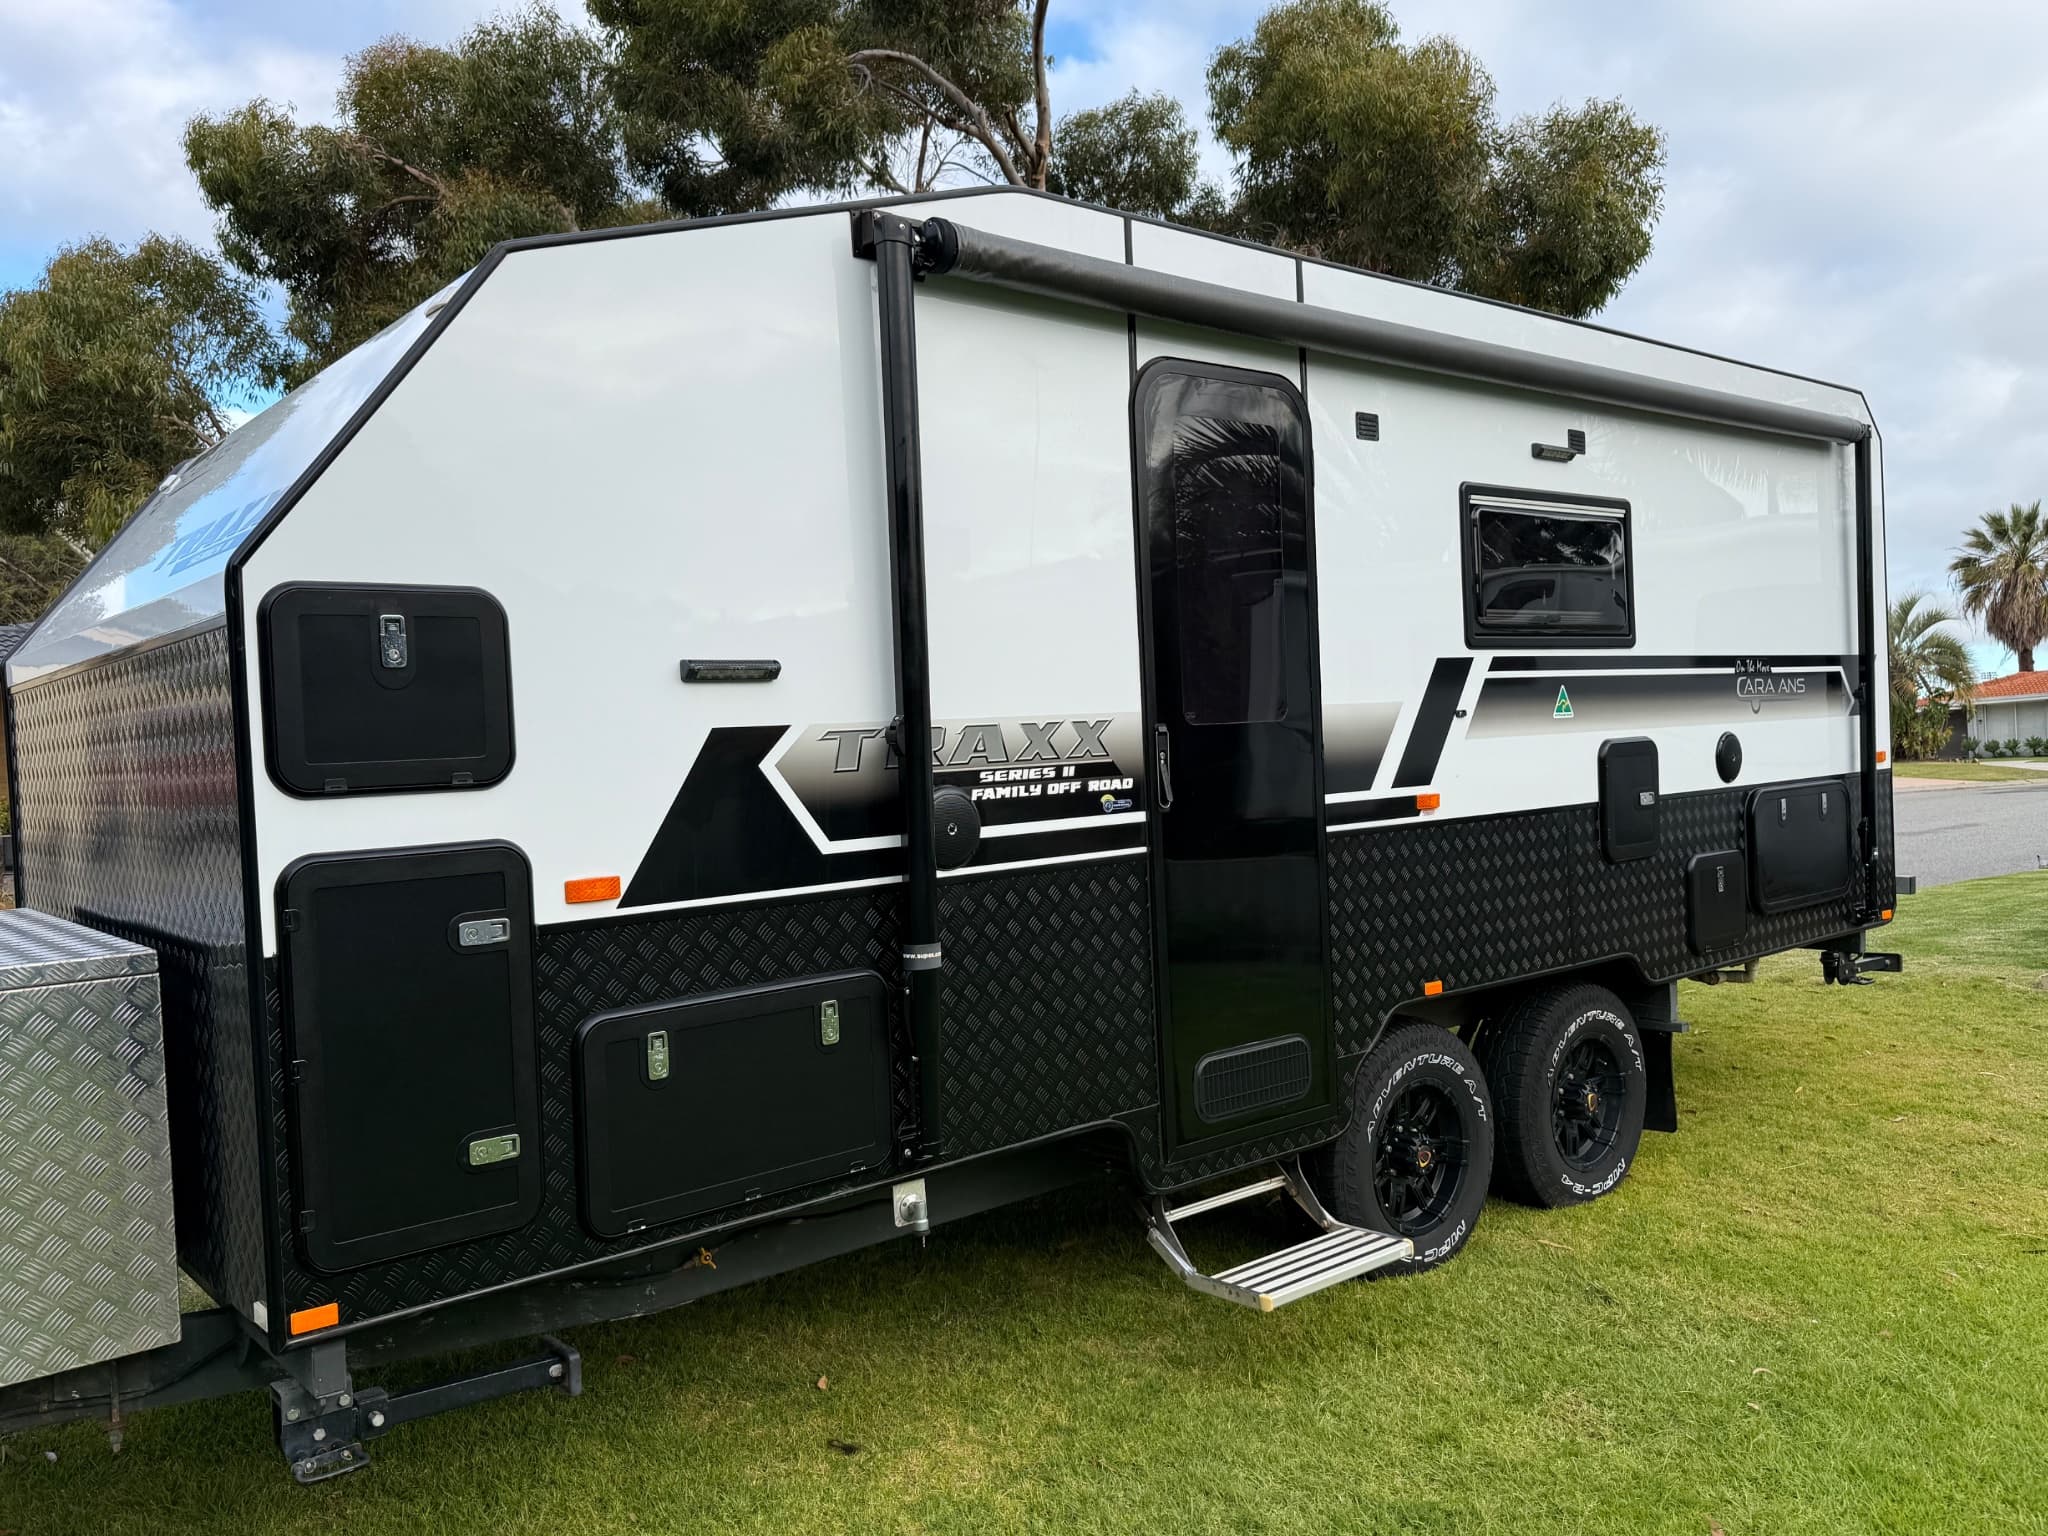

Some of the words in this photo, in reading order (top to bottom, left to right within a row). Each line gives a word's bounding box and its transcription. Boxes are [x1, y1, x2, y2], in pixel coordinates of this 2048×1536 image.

[971, 784, 1041, 801] FAMILY
[1048, 781, 1082, 795] OFF
[1088, 777, 1134, 792] ROAD
[980, 767, 1057, 783] SERIES
[1547, 1009, 1625, 1087] ADVENTURE
[1623, 1033, 1642, 1072] A/T
[1367, 1053, 1464, 1143] ADVENTURE
[1464, 1079, 1487, 1121] A/T
